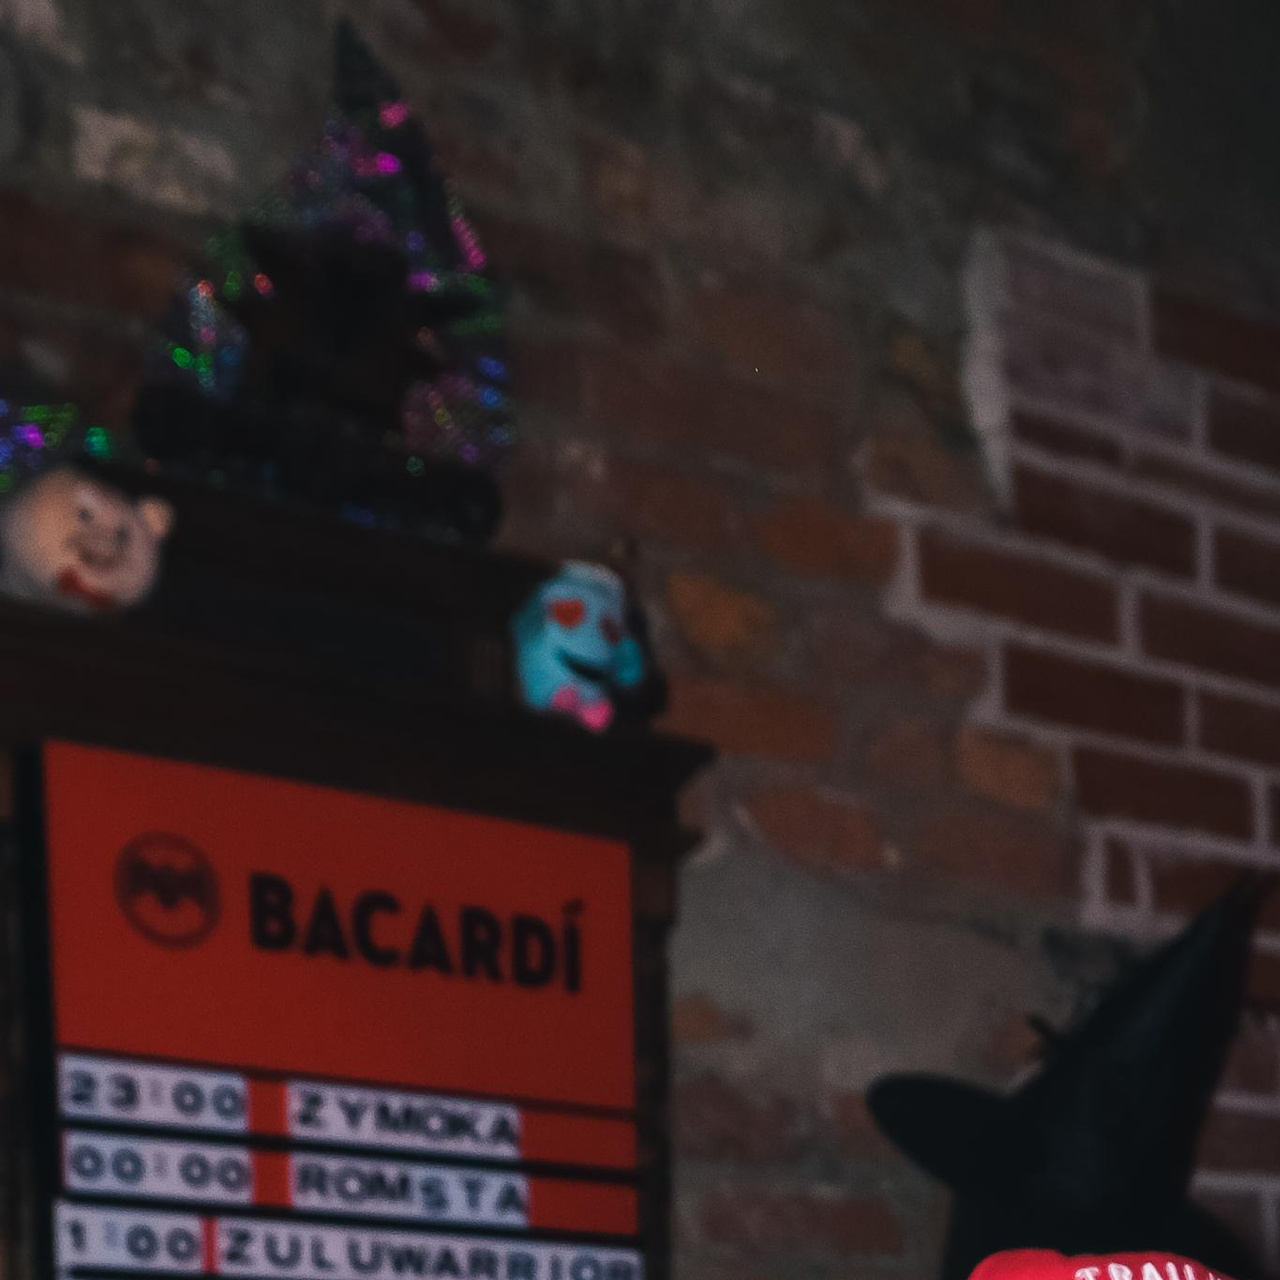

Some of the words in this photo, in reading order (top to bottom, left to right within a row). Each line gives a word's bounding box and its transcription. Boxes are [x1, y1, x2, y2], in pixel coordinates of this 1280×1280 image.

[247, 870, 587, 993] BACARDÍ
[299, 1090, 519, 1142] ZYMOKA
[299, 1162, 523, 1212] ROMSTA
